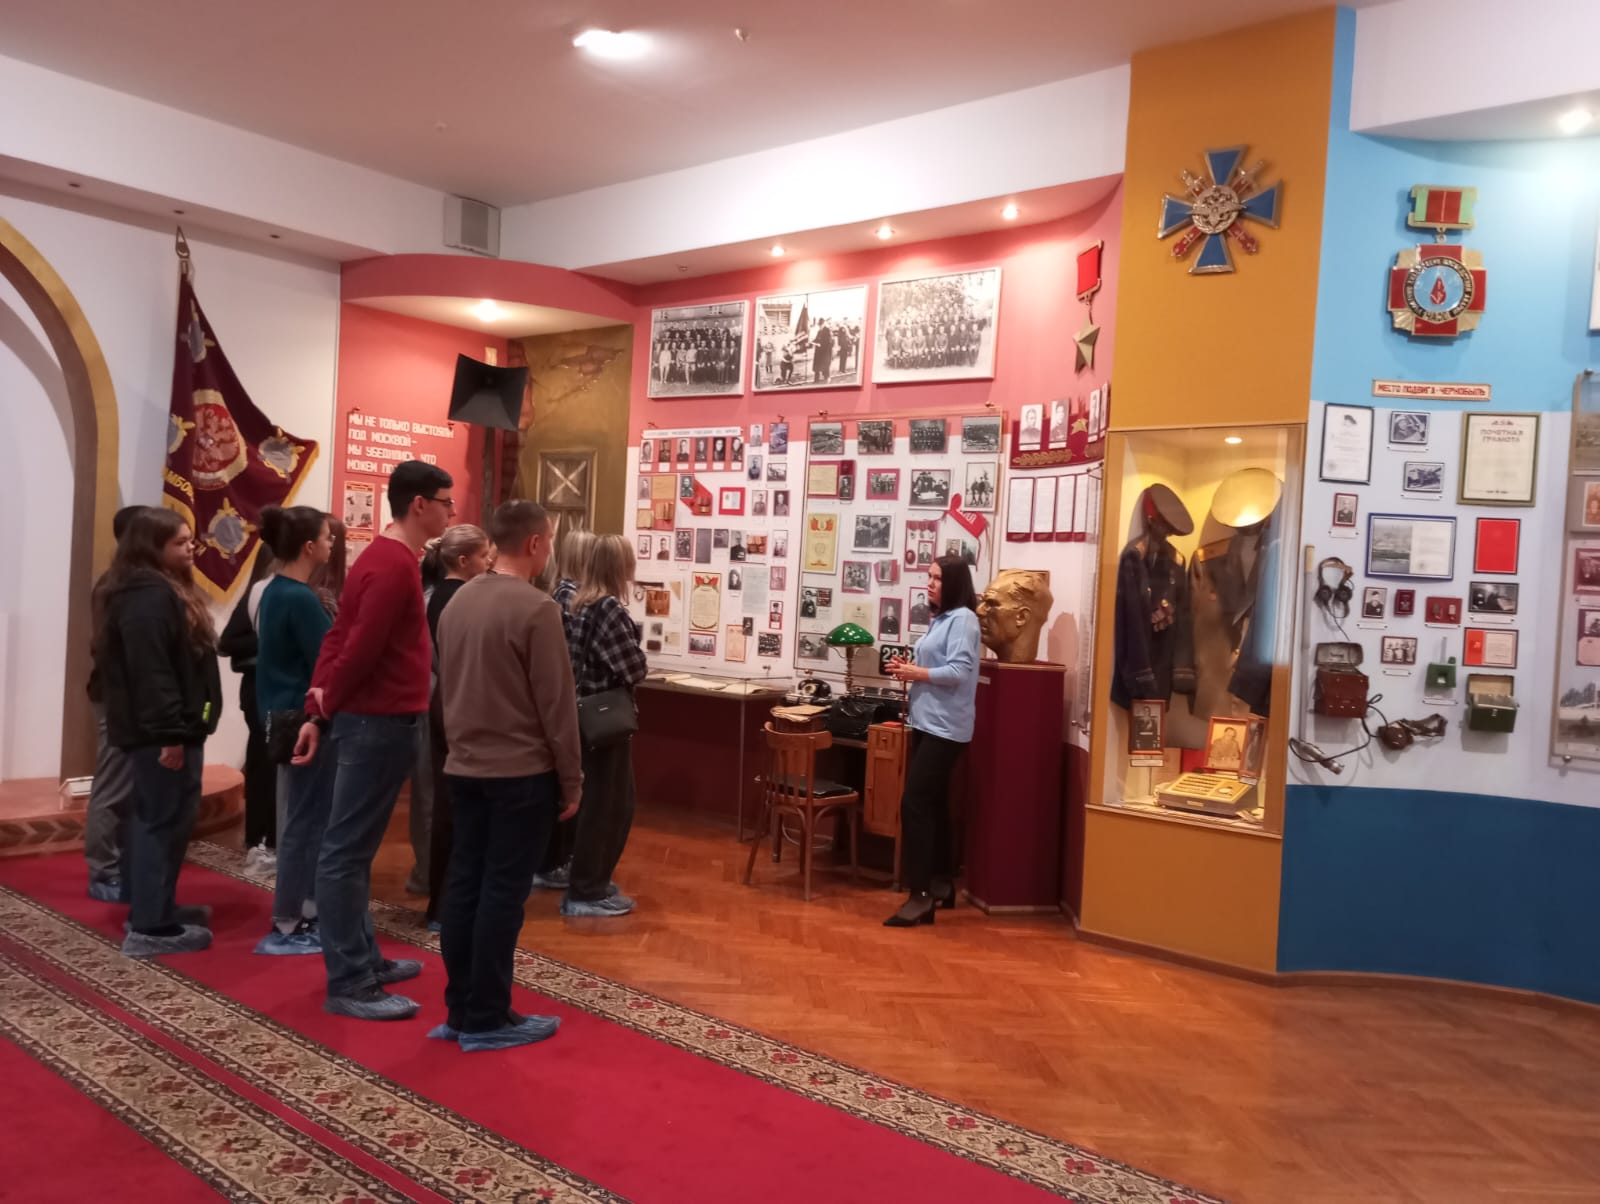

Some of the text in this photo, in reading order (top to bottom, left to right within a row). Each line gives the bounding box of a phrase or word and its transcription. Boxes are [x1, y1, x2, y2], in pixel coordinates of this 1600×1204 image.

[1377, 383, 1401, 393] МЕСТО
[349, 414, 364, 426] МЫ
[366, 416, 377, 427] НЕ
[379, 418, 410, 432] ТОЛЬКО
[349, 429, 367, 441] ПОД
[348, 444, 362, 456] МЫ
[421, 454, 437, 465] ЧТО
[347, 459, 378, 473] МОЖЕМ
